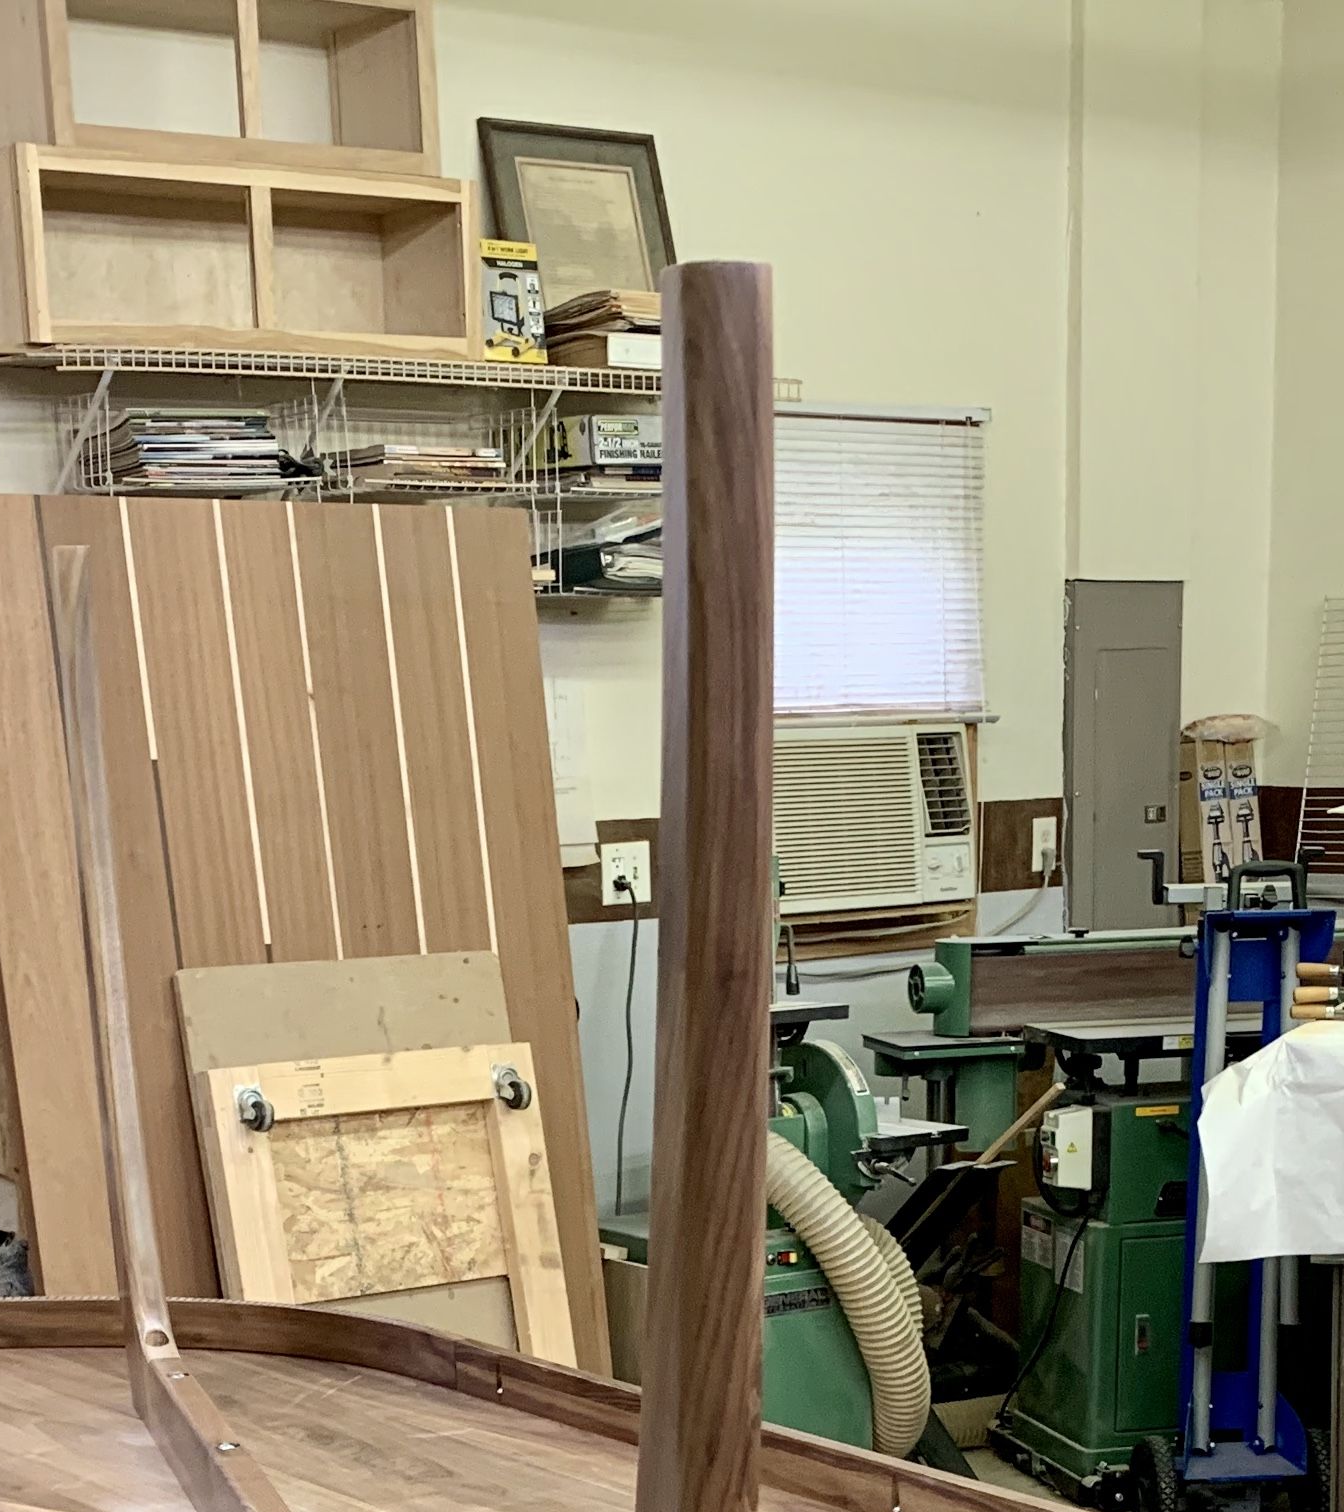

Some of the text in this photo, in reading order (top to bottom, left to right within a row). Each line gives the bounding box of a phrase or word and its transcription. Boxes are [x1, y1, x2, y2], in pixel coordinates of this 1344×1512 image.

[496, 259, 524, 268] HALOGEN
[599, 449, 662, 459] FINISHING NAILE
